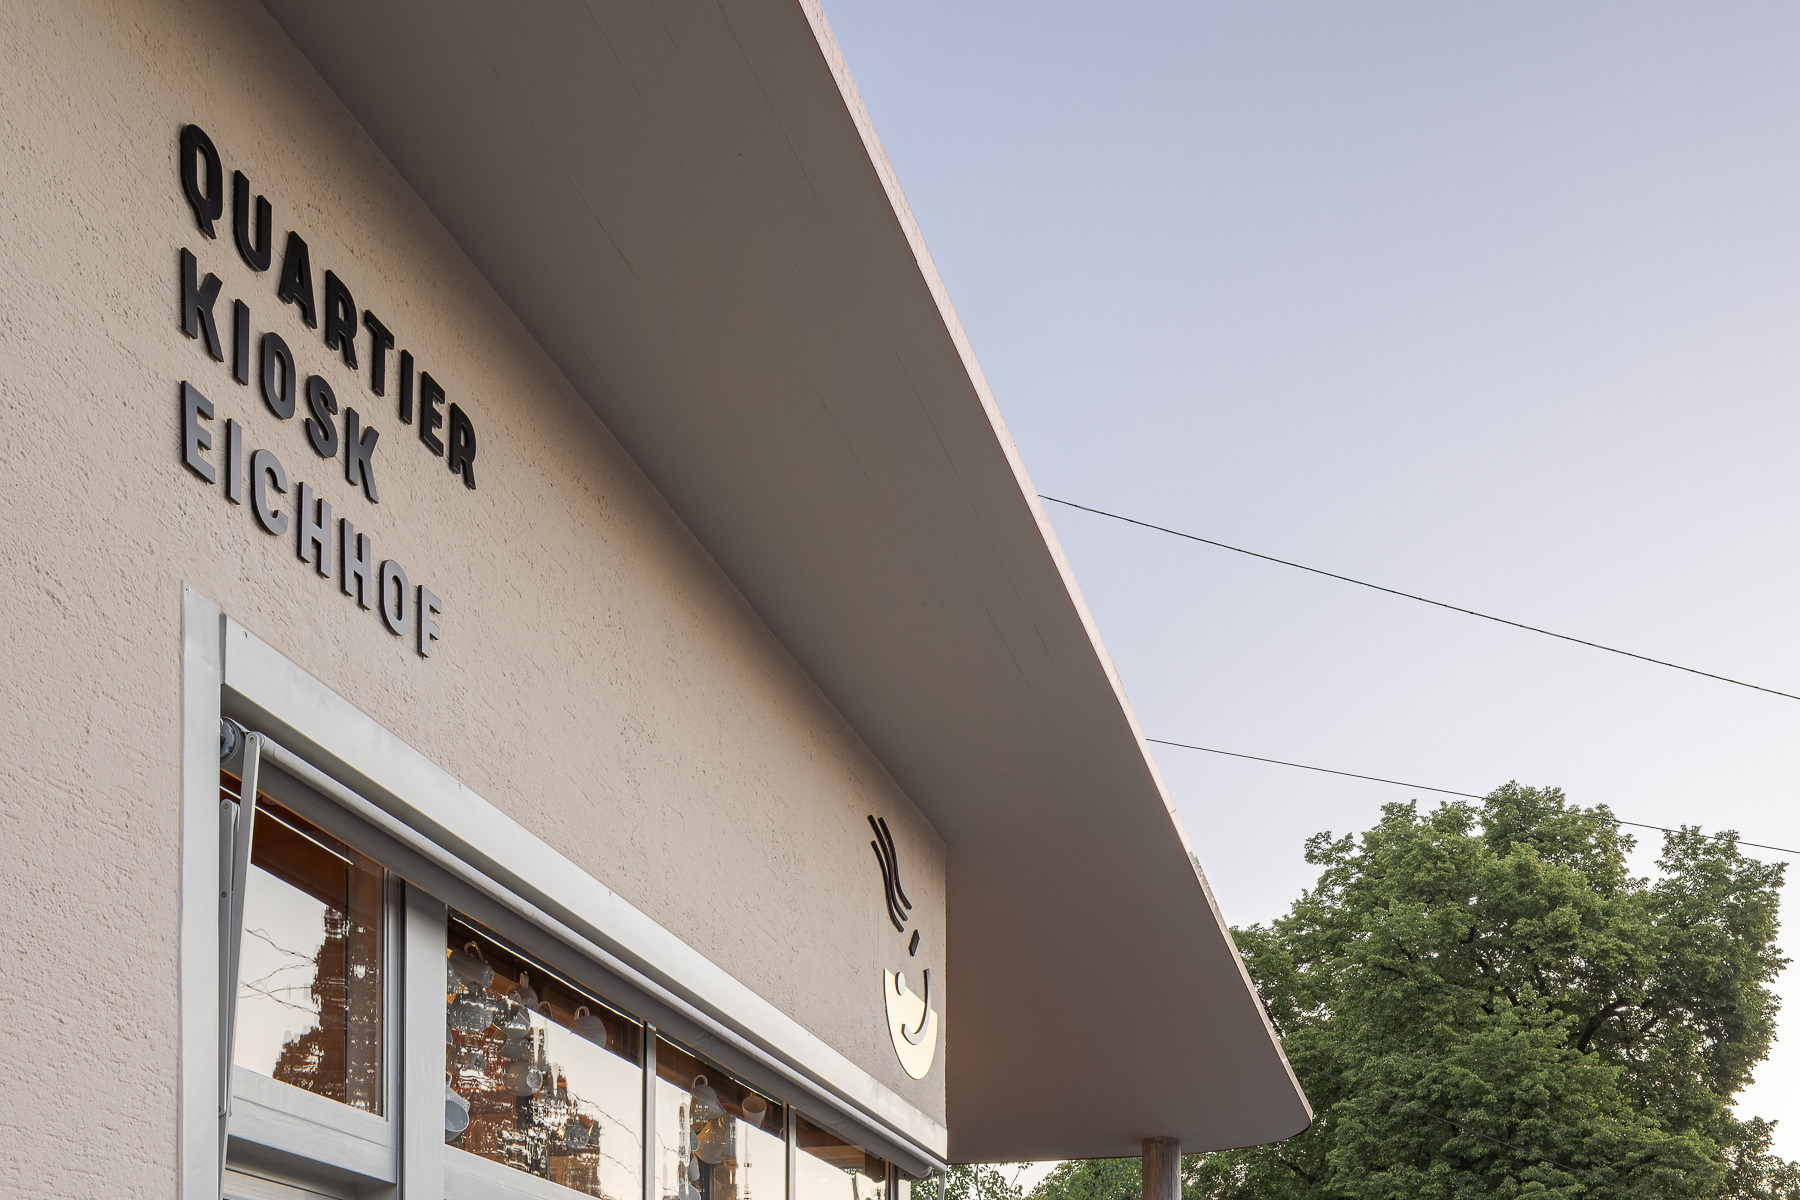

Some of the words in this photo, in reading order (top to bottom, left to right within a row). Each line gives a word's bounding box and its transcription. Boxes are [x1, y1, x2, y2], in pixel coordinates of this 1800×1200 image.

[180, 124, 476, 490] QUARTIER
[180, 247, 379, 504] KIOSK
[180, 380, 442, 659] EICHHOF
